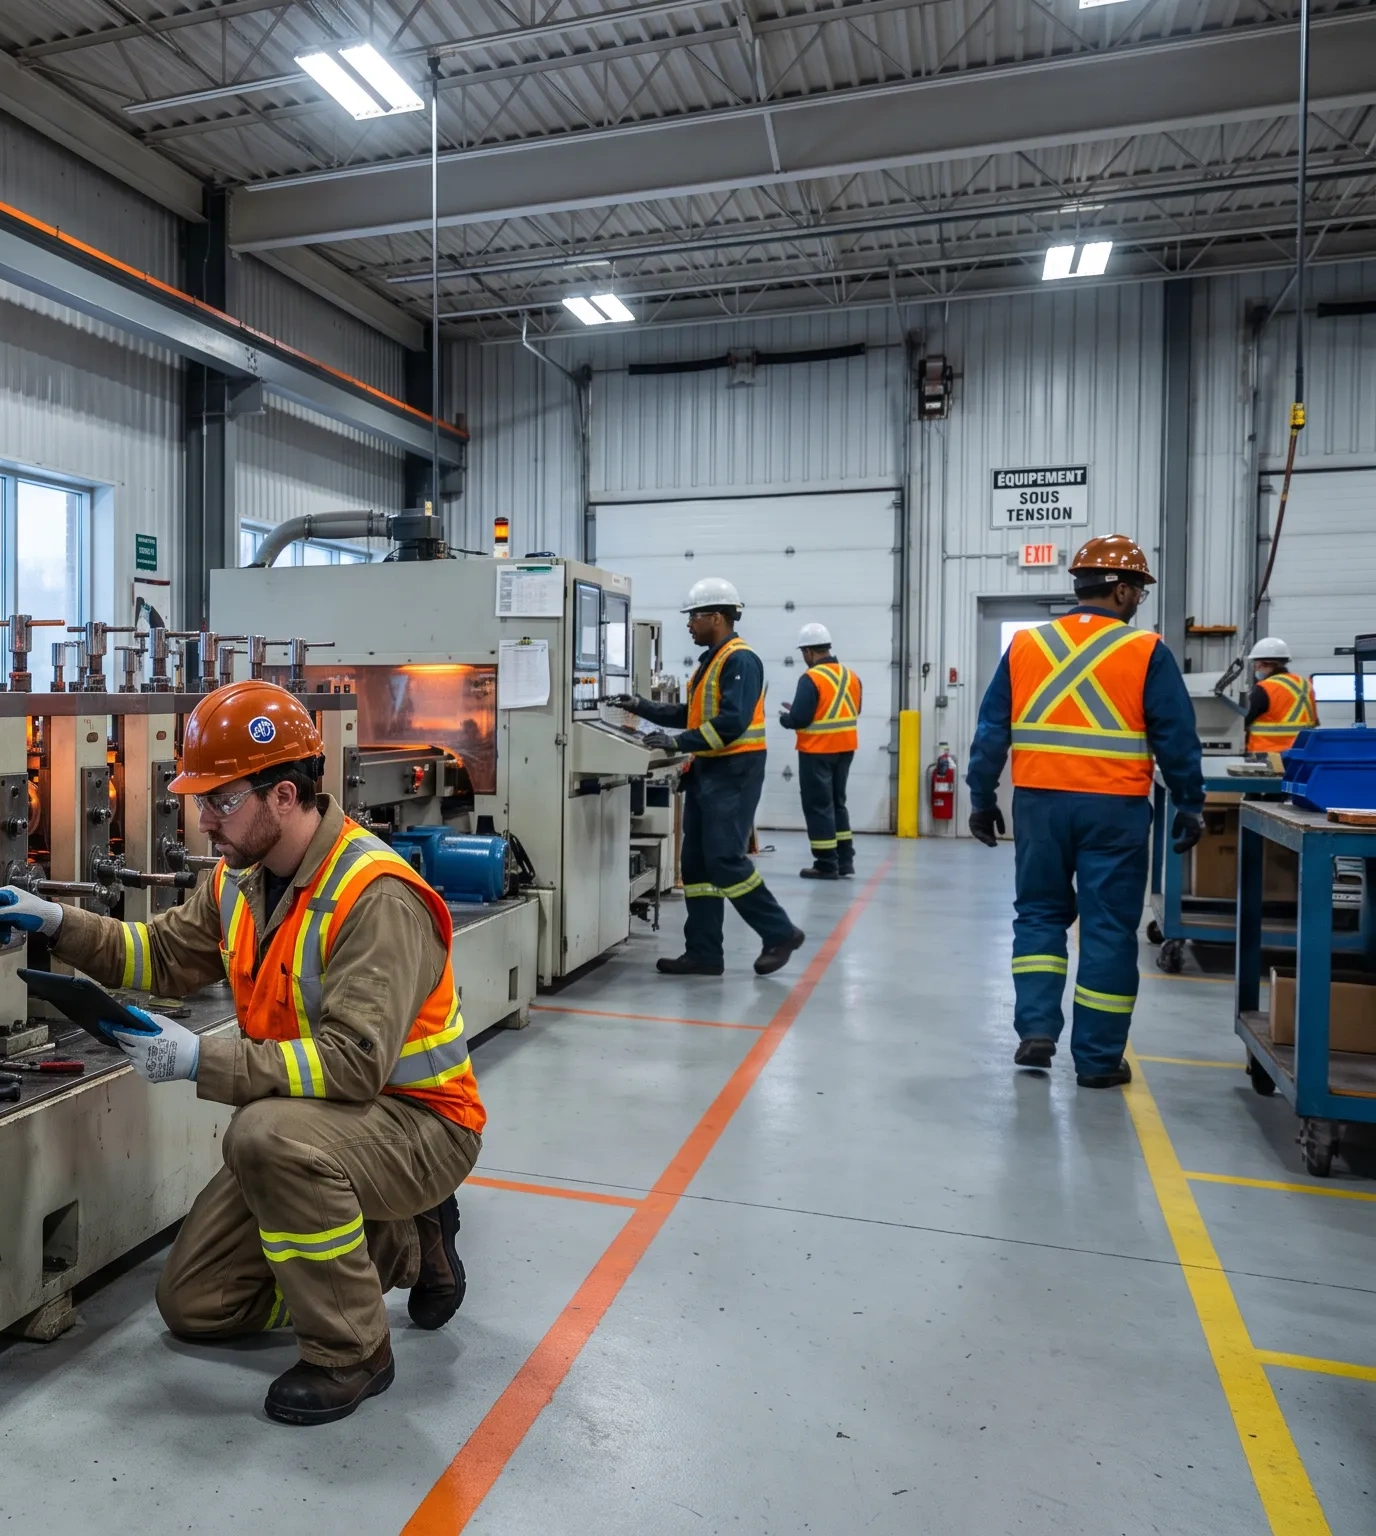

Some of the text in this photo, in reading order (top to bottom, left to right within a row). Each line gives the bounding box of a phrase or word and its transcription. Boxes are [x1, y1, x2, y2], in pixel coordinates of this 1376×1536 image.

[997, 470, 1084, 487] ÉQUIPEMENT
[1019, 490, 1060, 505] SOUS
[1006, 506, 1073, 522] TENSION
[1024, 544, 1053, 564] EXIT
